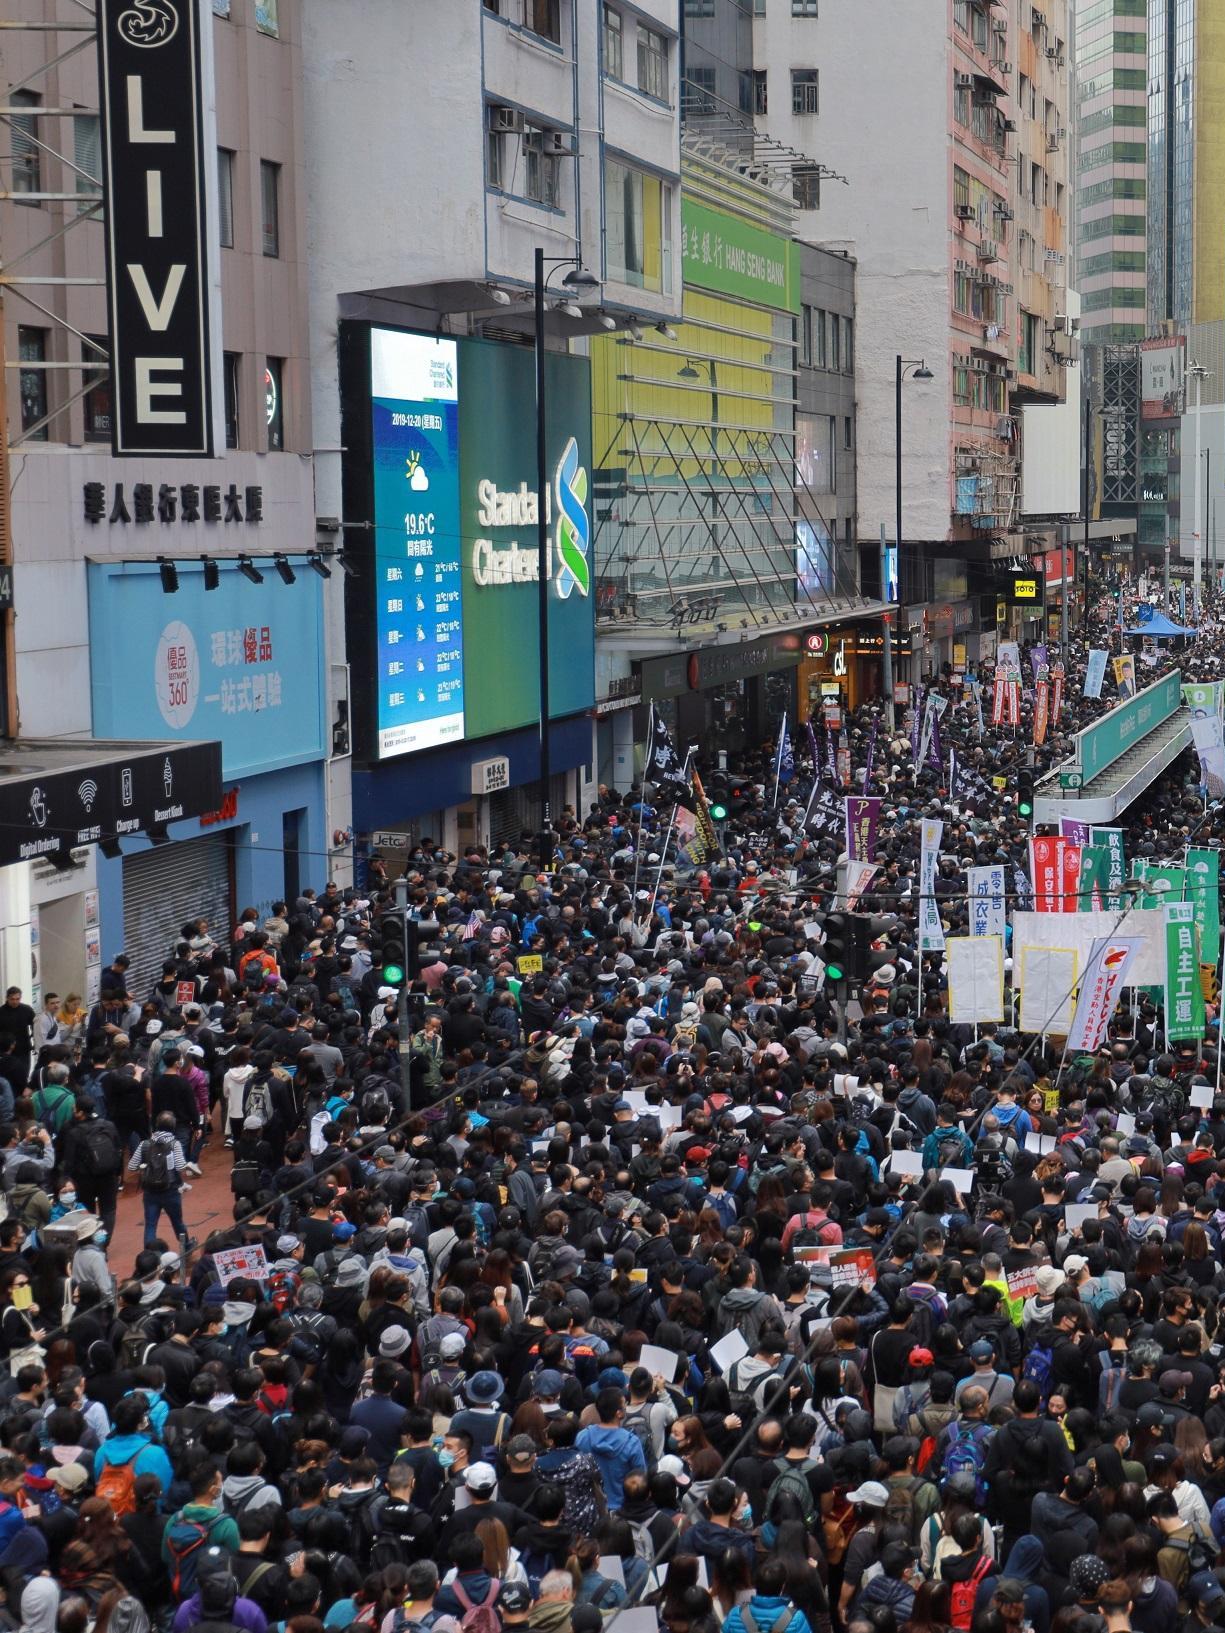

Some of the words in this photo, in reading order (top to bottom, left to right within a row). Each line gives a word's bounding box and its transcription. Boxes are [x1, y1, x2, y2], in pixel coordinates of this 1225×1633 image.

[126, 75, 188, 425] LIVE
[725, 244, 746, 274] HANG
[746, 252, 766, 281] SENG
[766, 258, 784, 288] BANK
[210, 626, 272, 668] 環球優品
[204, 671, 282, 714] 一站式體驗
[116, 819, 132, 832] Charge
[154, 808, 170, 822] Dessert
[20, 840, 38, 858] Digital
[38, 837, 60, 854] Ordering
[1176, 926, 1194, 1023] 自主工運
